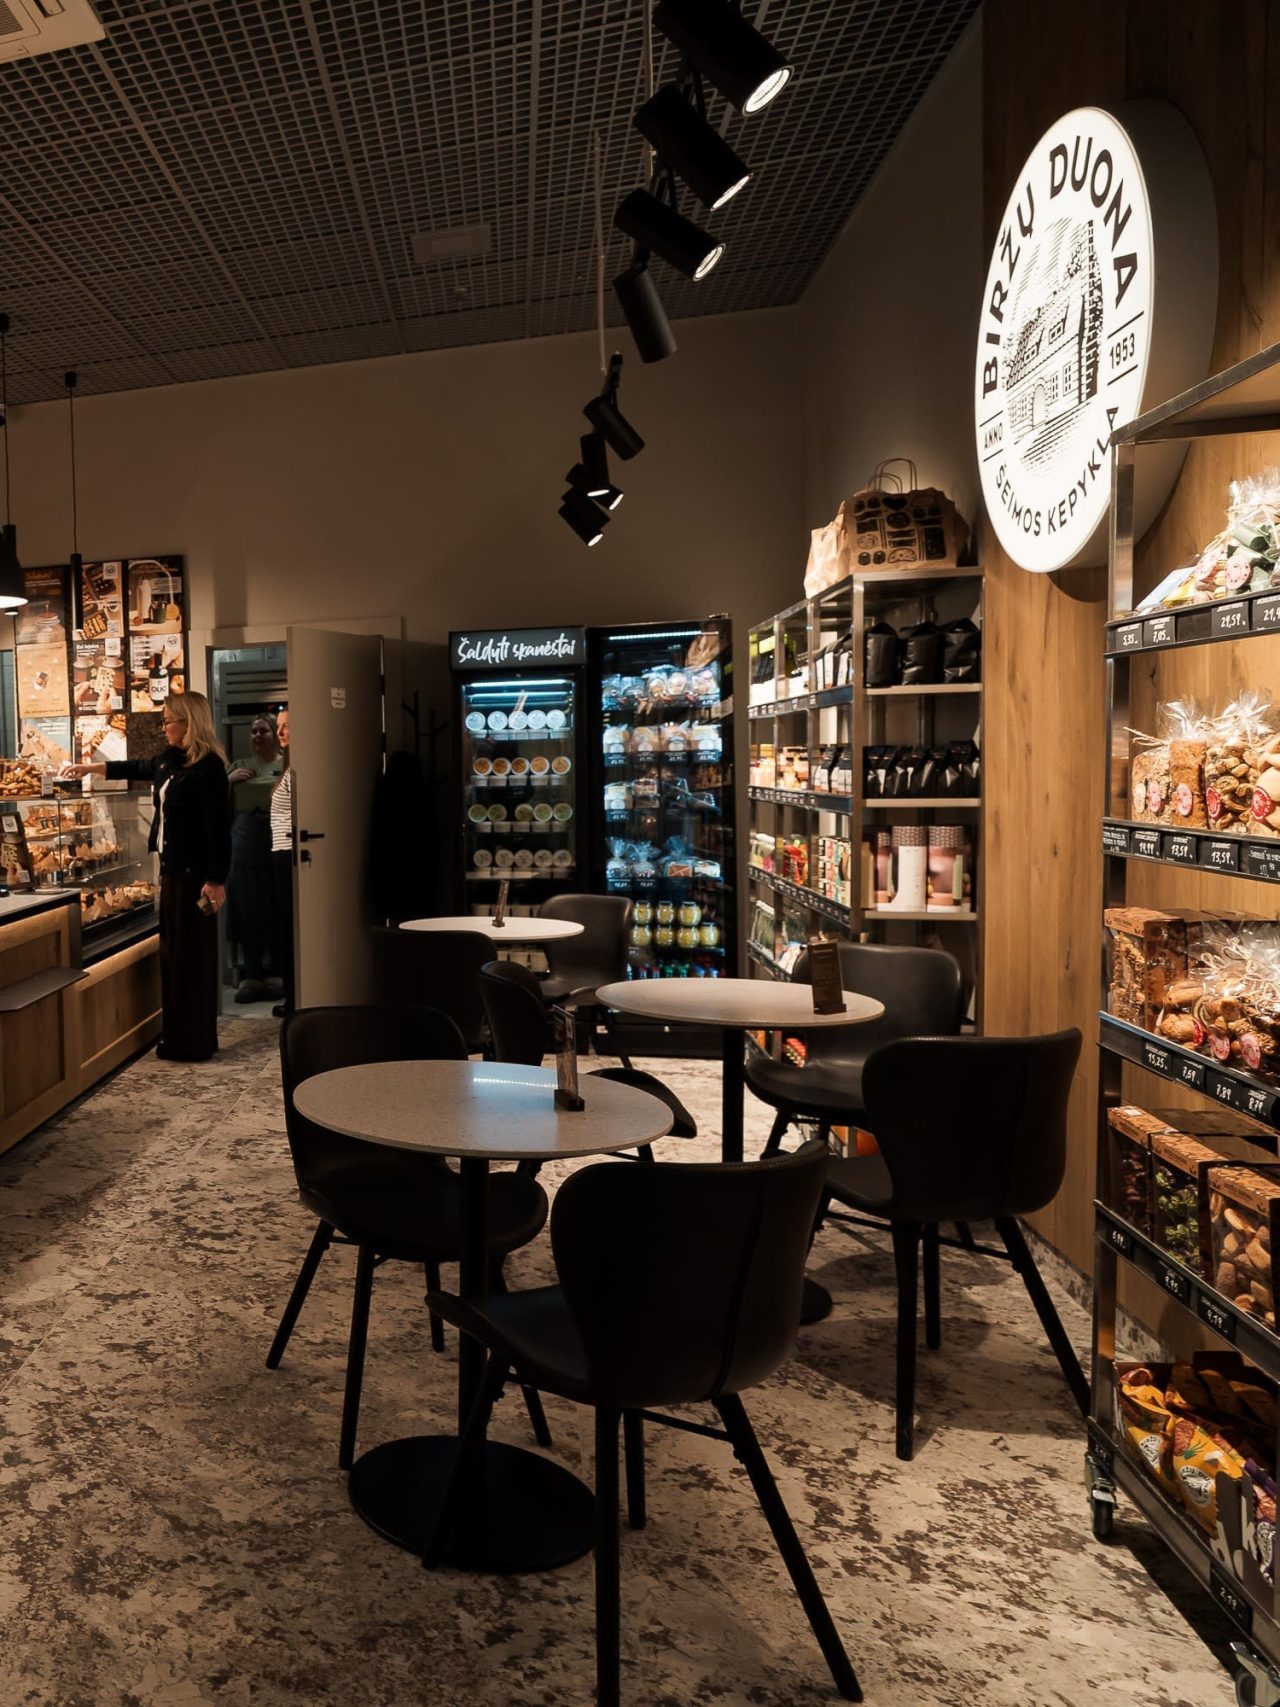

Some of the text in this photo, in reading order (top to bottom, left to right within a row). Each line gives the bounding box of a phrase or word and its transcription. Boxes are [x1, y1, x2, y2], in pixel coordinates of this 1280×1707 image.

[982, 135, 1139, 400] BIRŽŲ DUONA
[1109, 331, 1136, 370] 1953
[983, 421, 1003, 451] ANNO
[995, 405, 1120, 537] ŠEIMOS KEPYKLA
[457, 631, 577, 665] Šaldyti skanėstai
